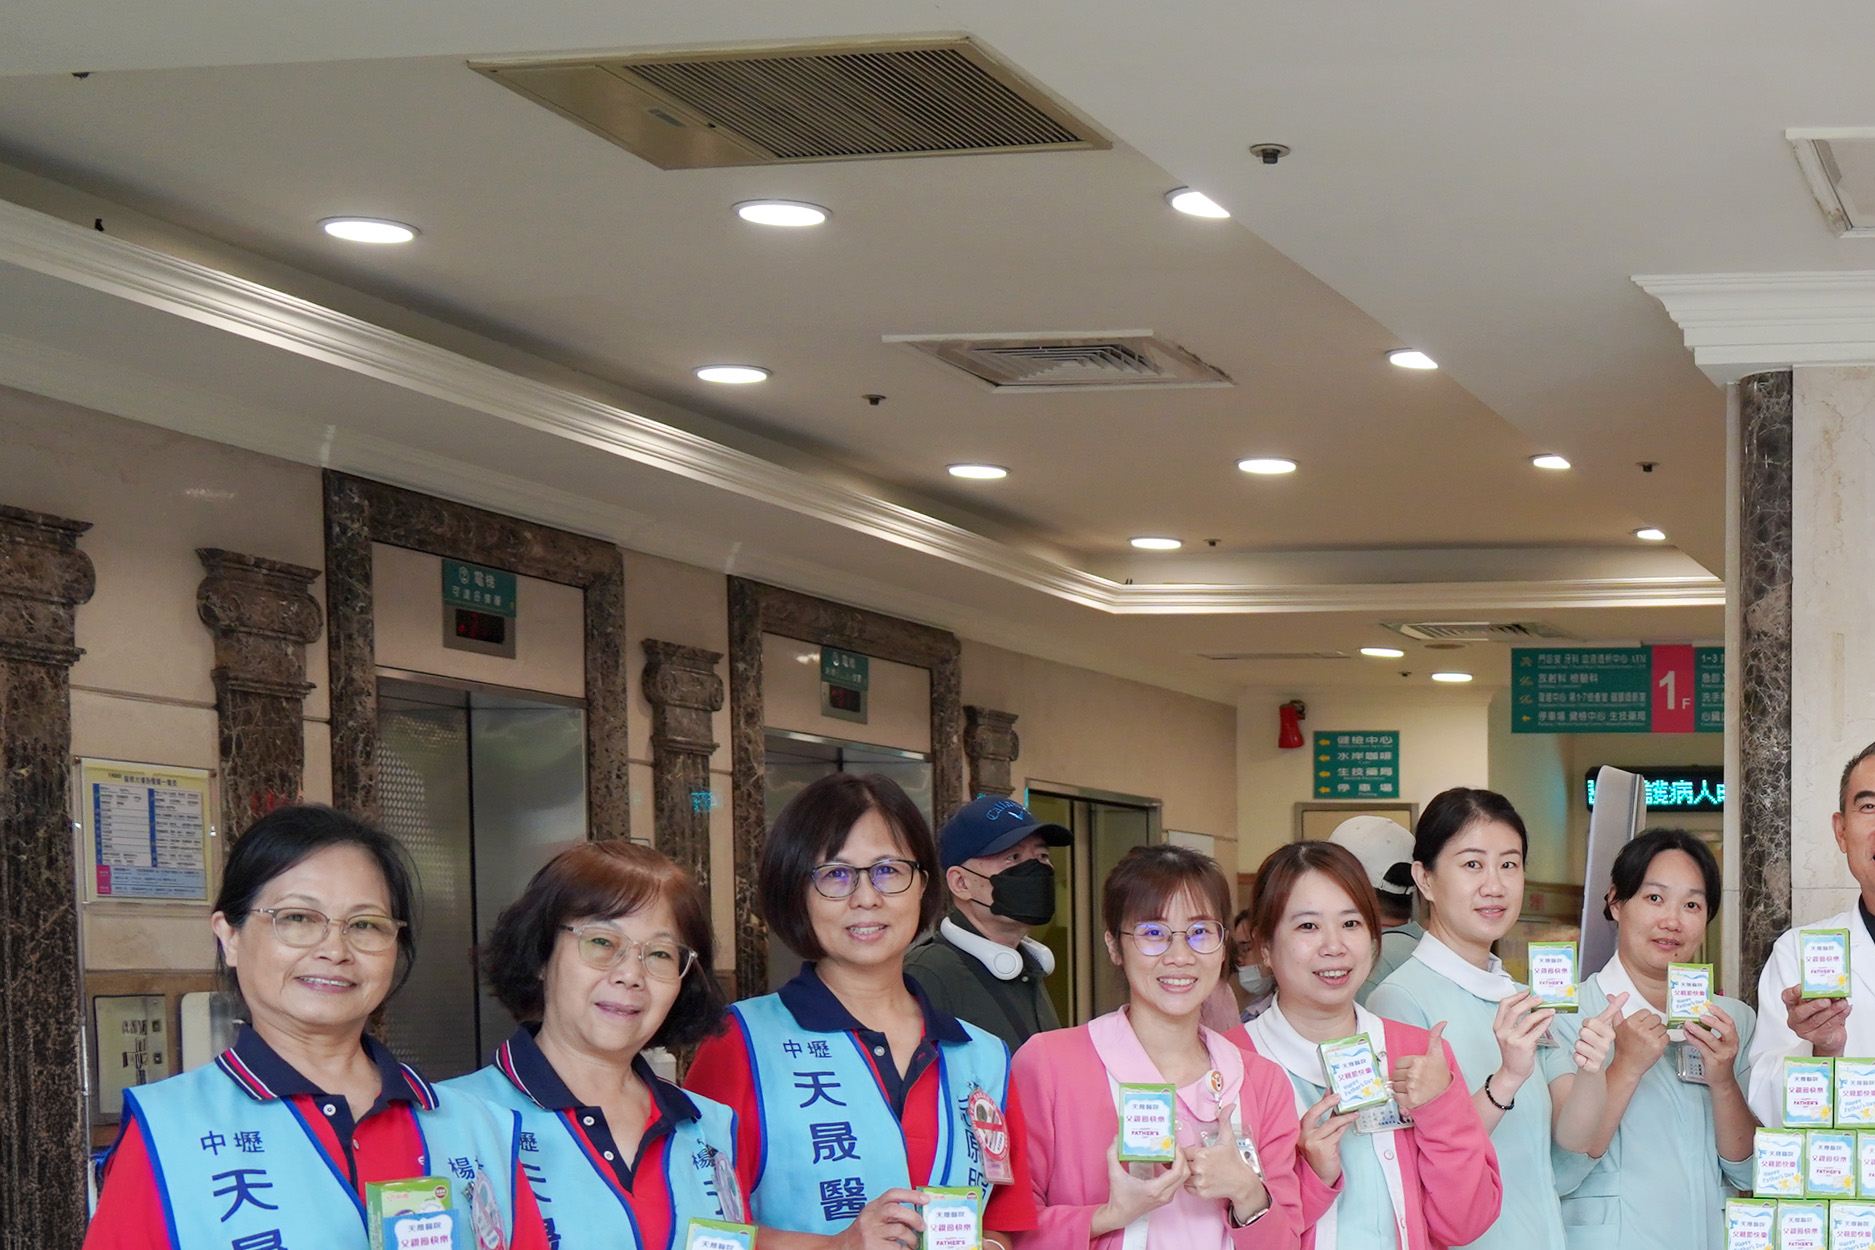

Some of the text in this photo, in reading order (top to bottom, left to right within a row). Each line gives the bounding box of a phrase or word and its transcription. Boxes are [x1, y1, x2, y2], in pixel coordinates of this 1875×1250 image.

[1659, 671, 1675, 710] 1
[1682, 698, 1691, 709] F
[1337, 736, 1393, 744] 健檢中心
[1337, 752, 1392, 760] 水岸咖啡
[1337, 767, 1393, 776] 生技藥局
[1337, 784, 1393, 792] 停車場
[782, 1039, 833, 1059] 中壢
[200, 1130, 266, 1156] 中壢
